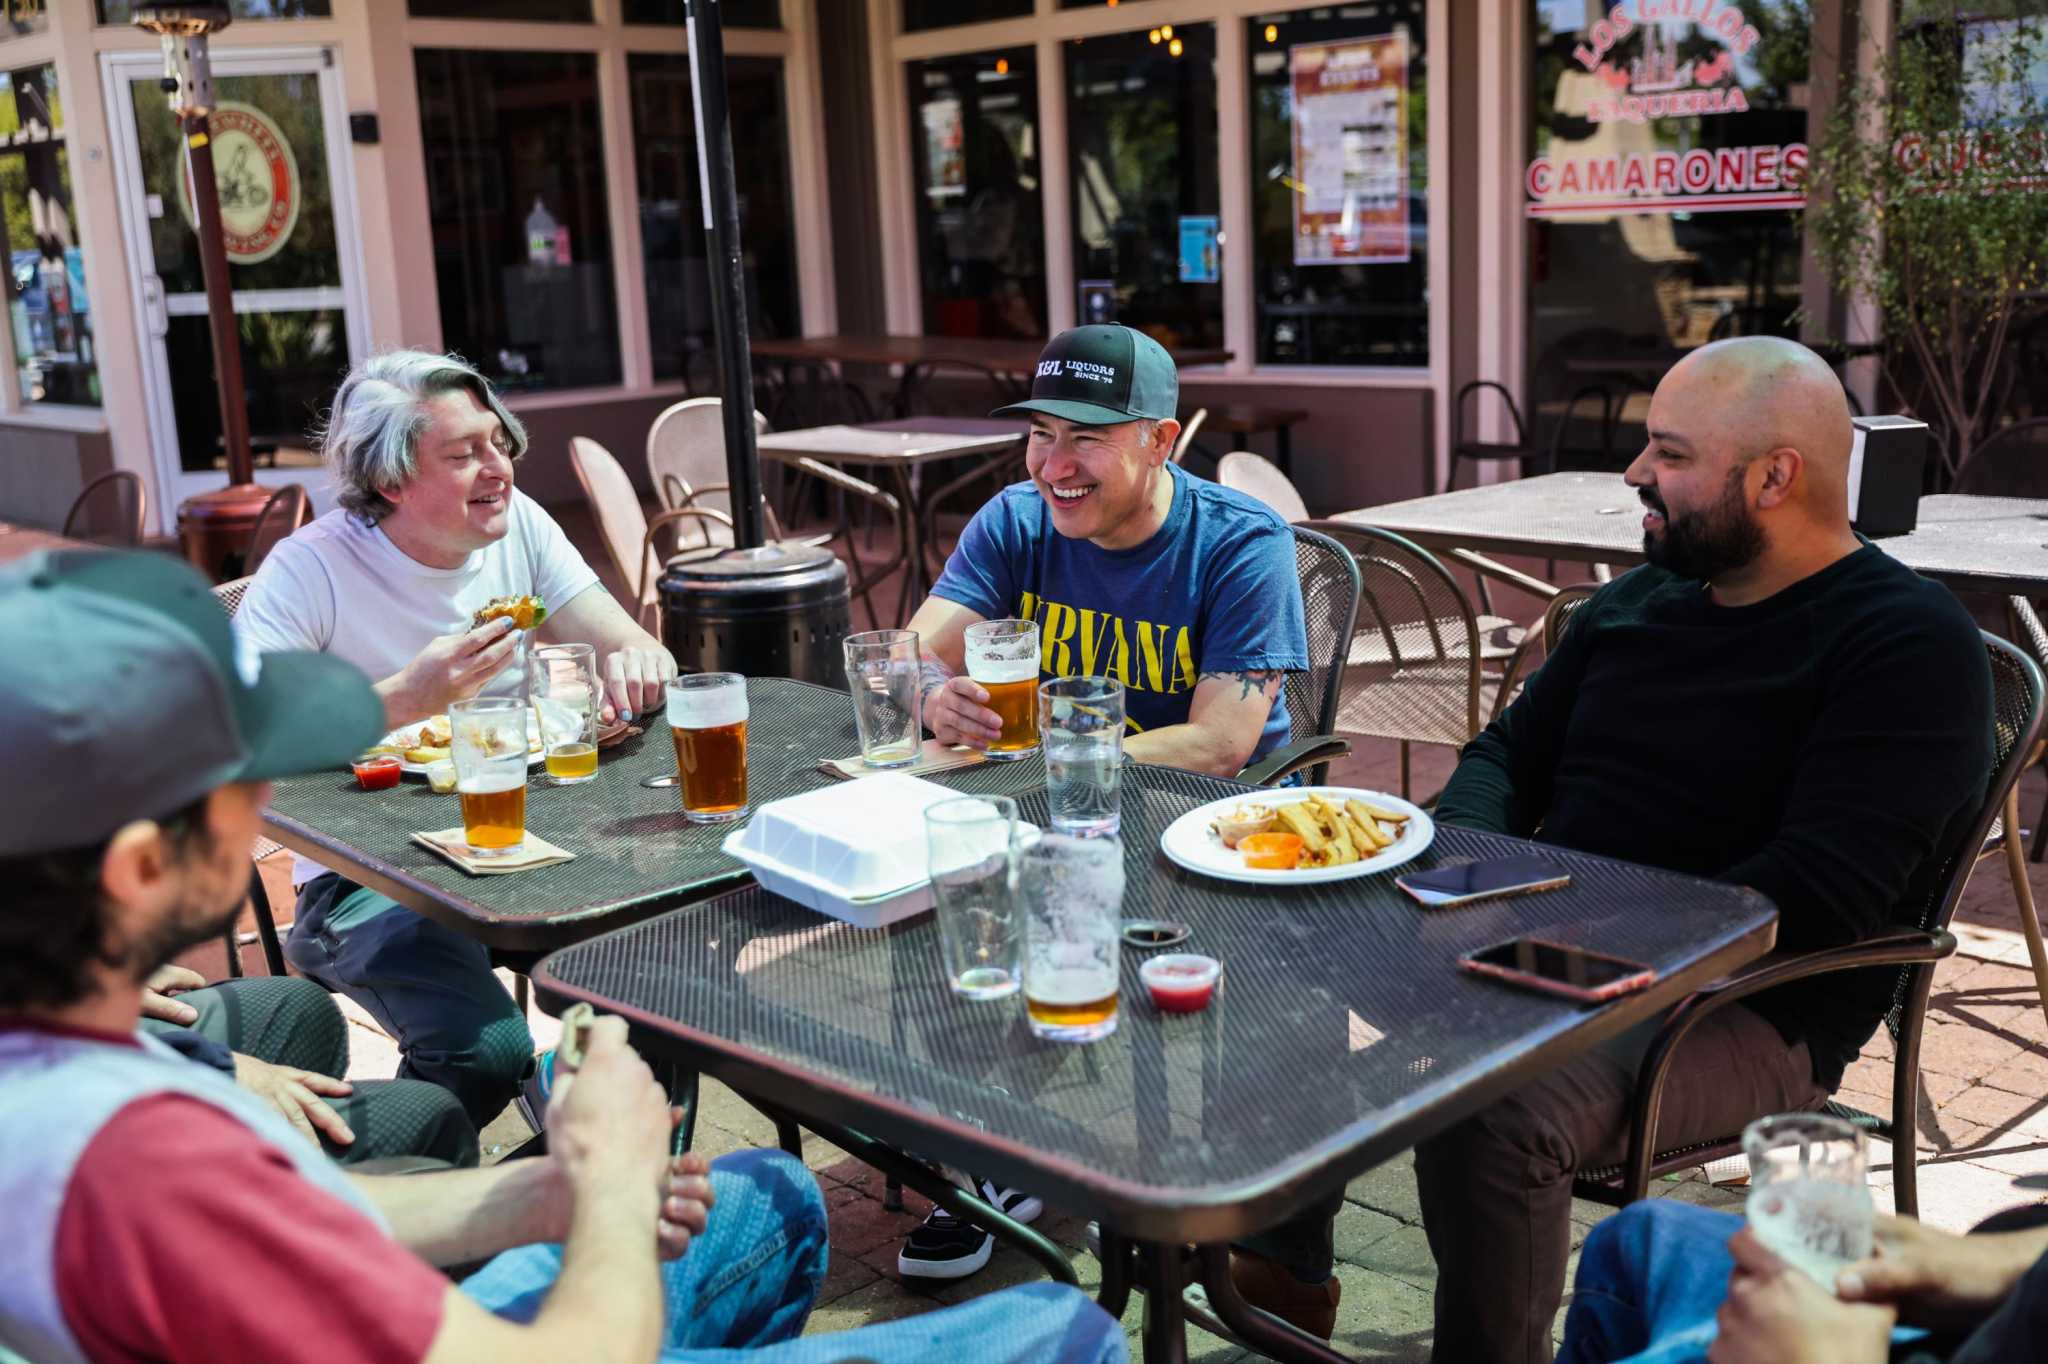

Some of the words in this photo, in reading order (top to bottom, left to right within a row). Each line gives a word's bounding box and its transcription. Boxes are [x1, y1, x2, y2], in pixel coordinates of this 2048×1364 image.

[1573, 4, 1633, 71] LOS
[1587, 86, 1749, 123] TAQUERIA
[1526, 143, 1808, 200] CAMARONES
[1065, 360, 1115, 376] LIQUORS
[1074, 371, 1100, 381] SINCE
[1019, 591, 1197, 695] RVANA
